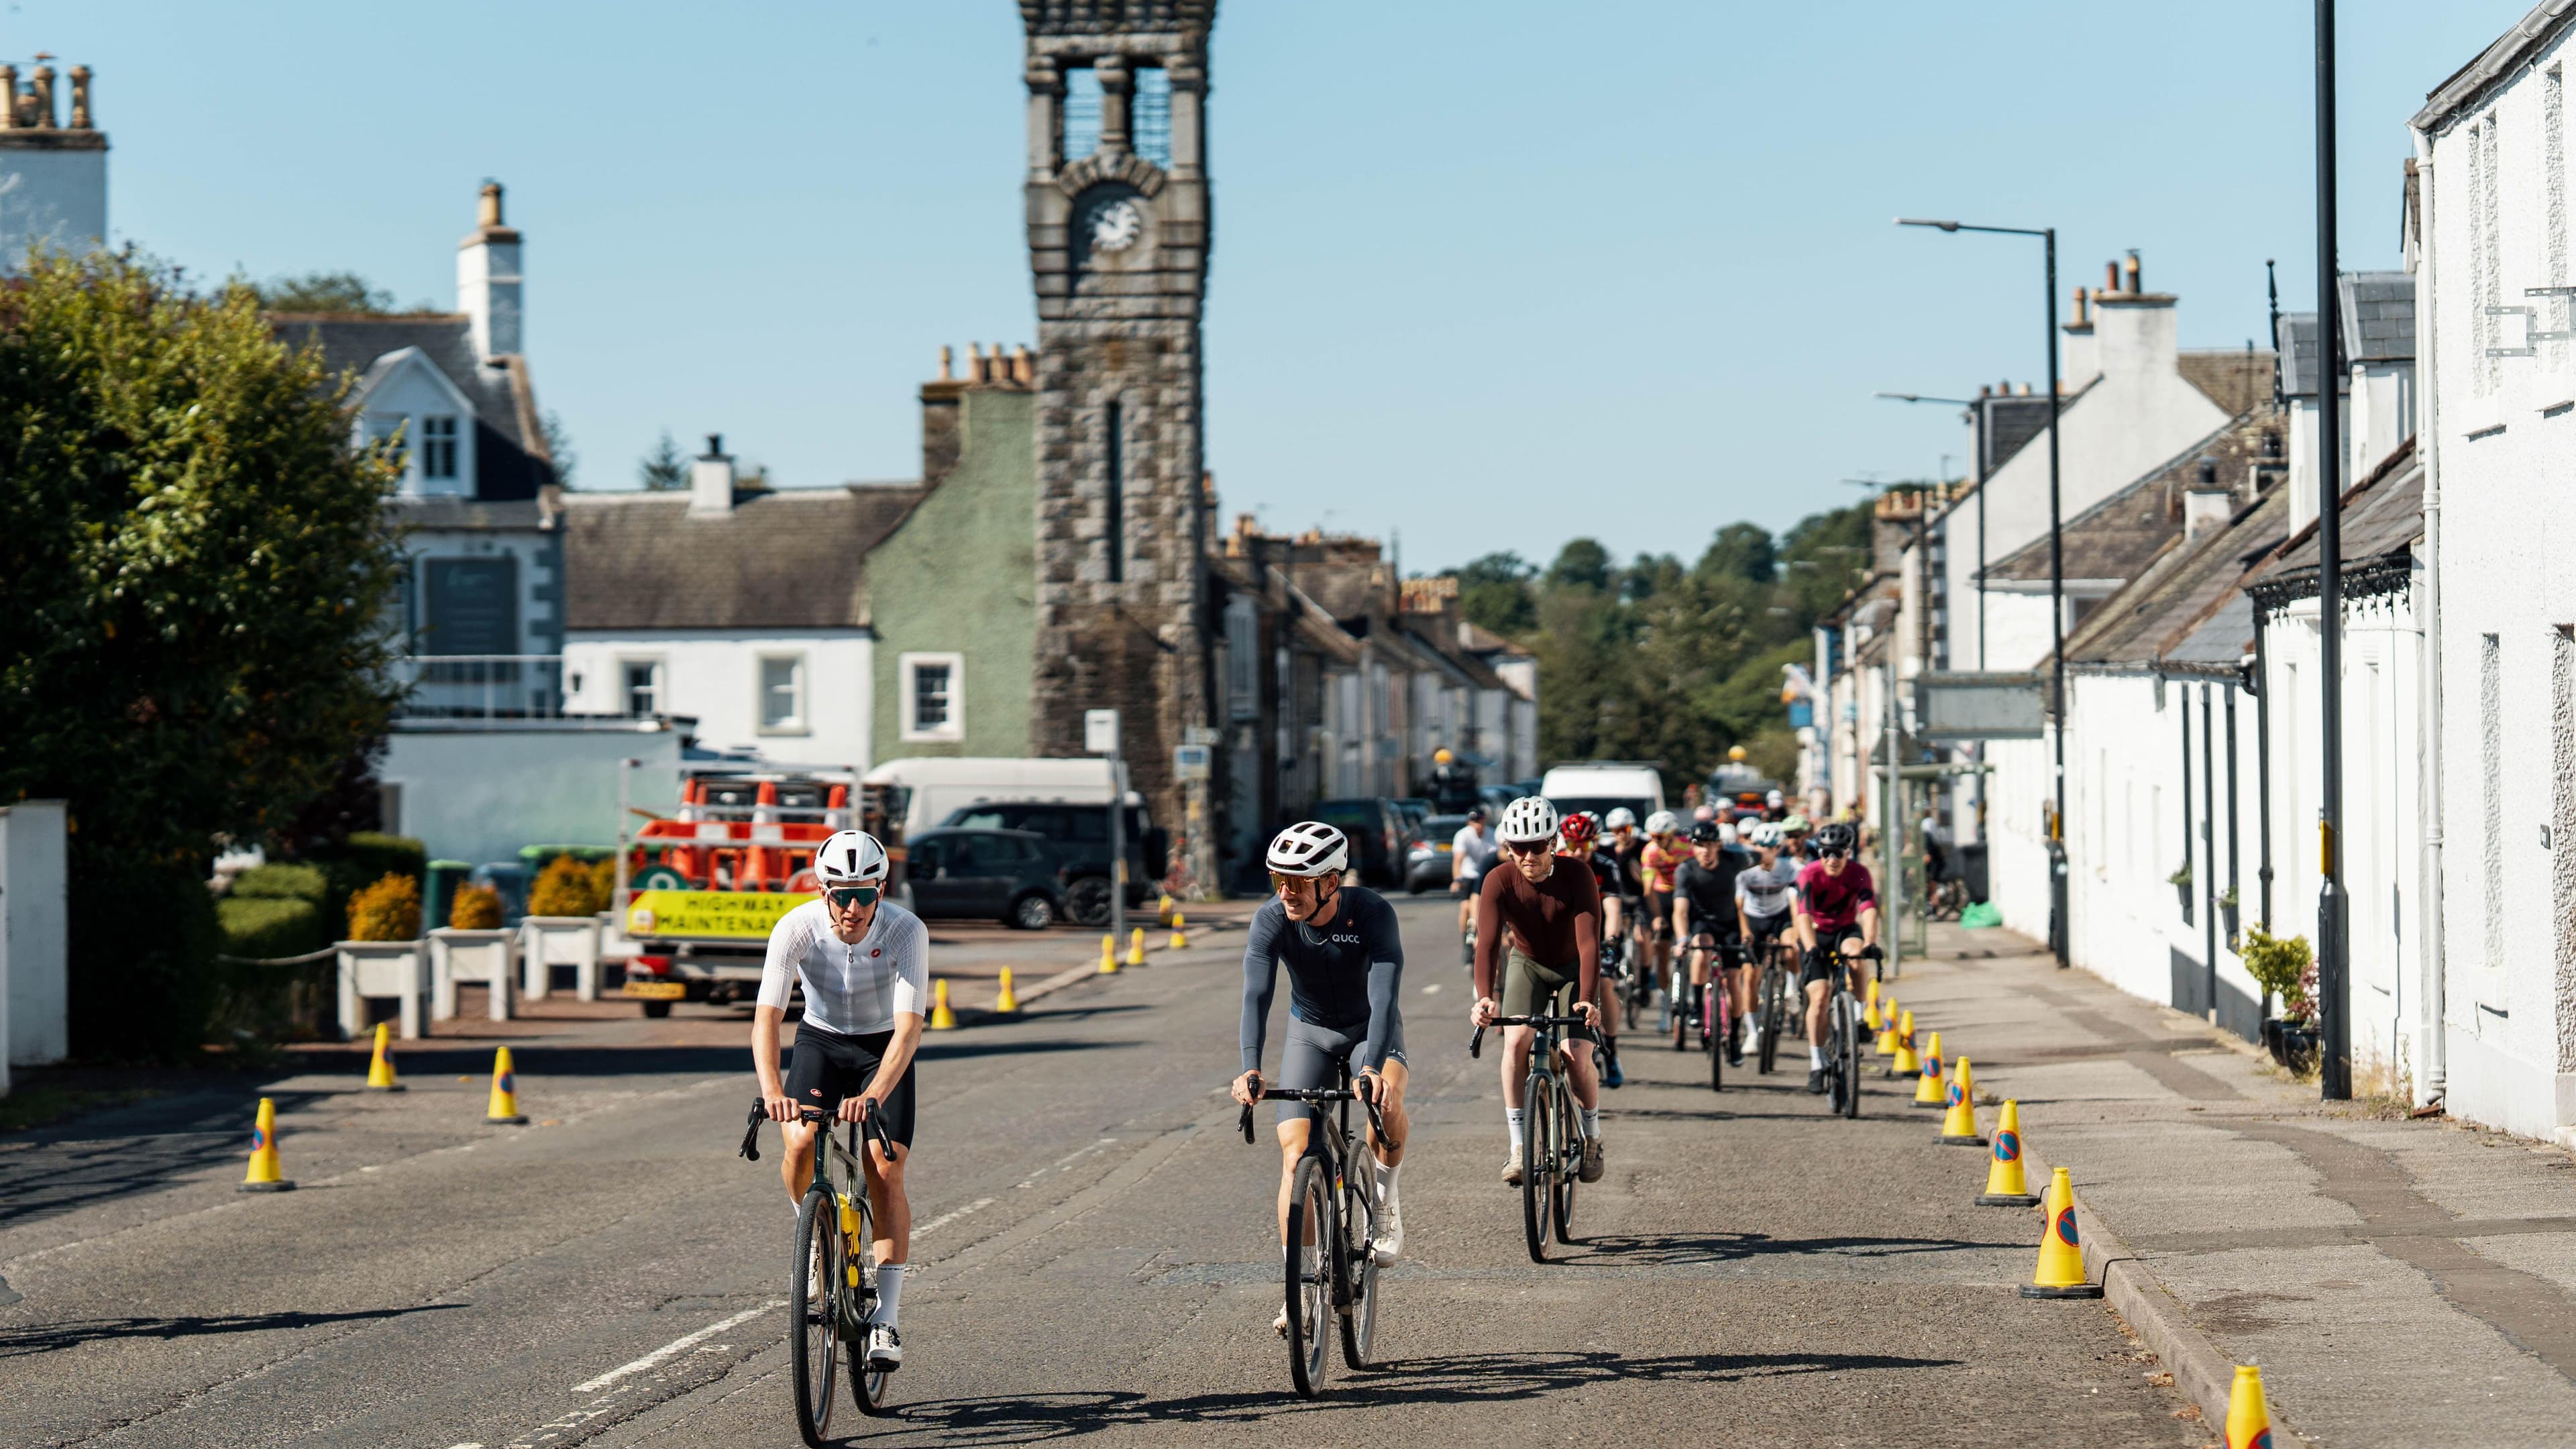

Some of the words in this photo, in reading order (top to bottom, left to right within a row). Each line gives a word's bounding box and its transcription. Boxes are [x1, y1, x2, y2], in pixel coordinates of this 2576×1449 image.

[1318, 864, 1332, 874] SMITH
[686, 896, 786, 912] HIGHWAY
[1332, 934, 1360, 944] QUCC
